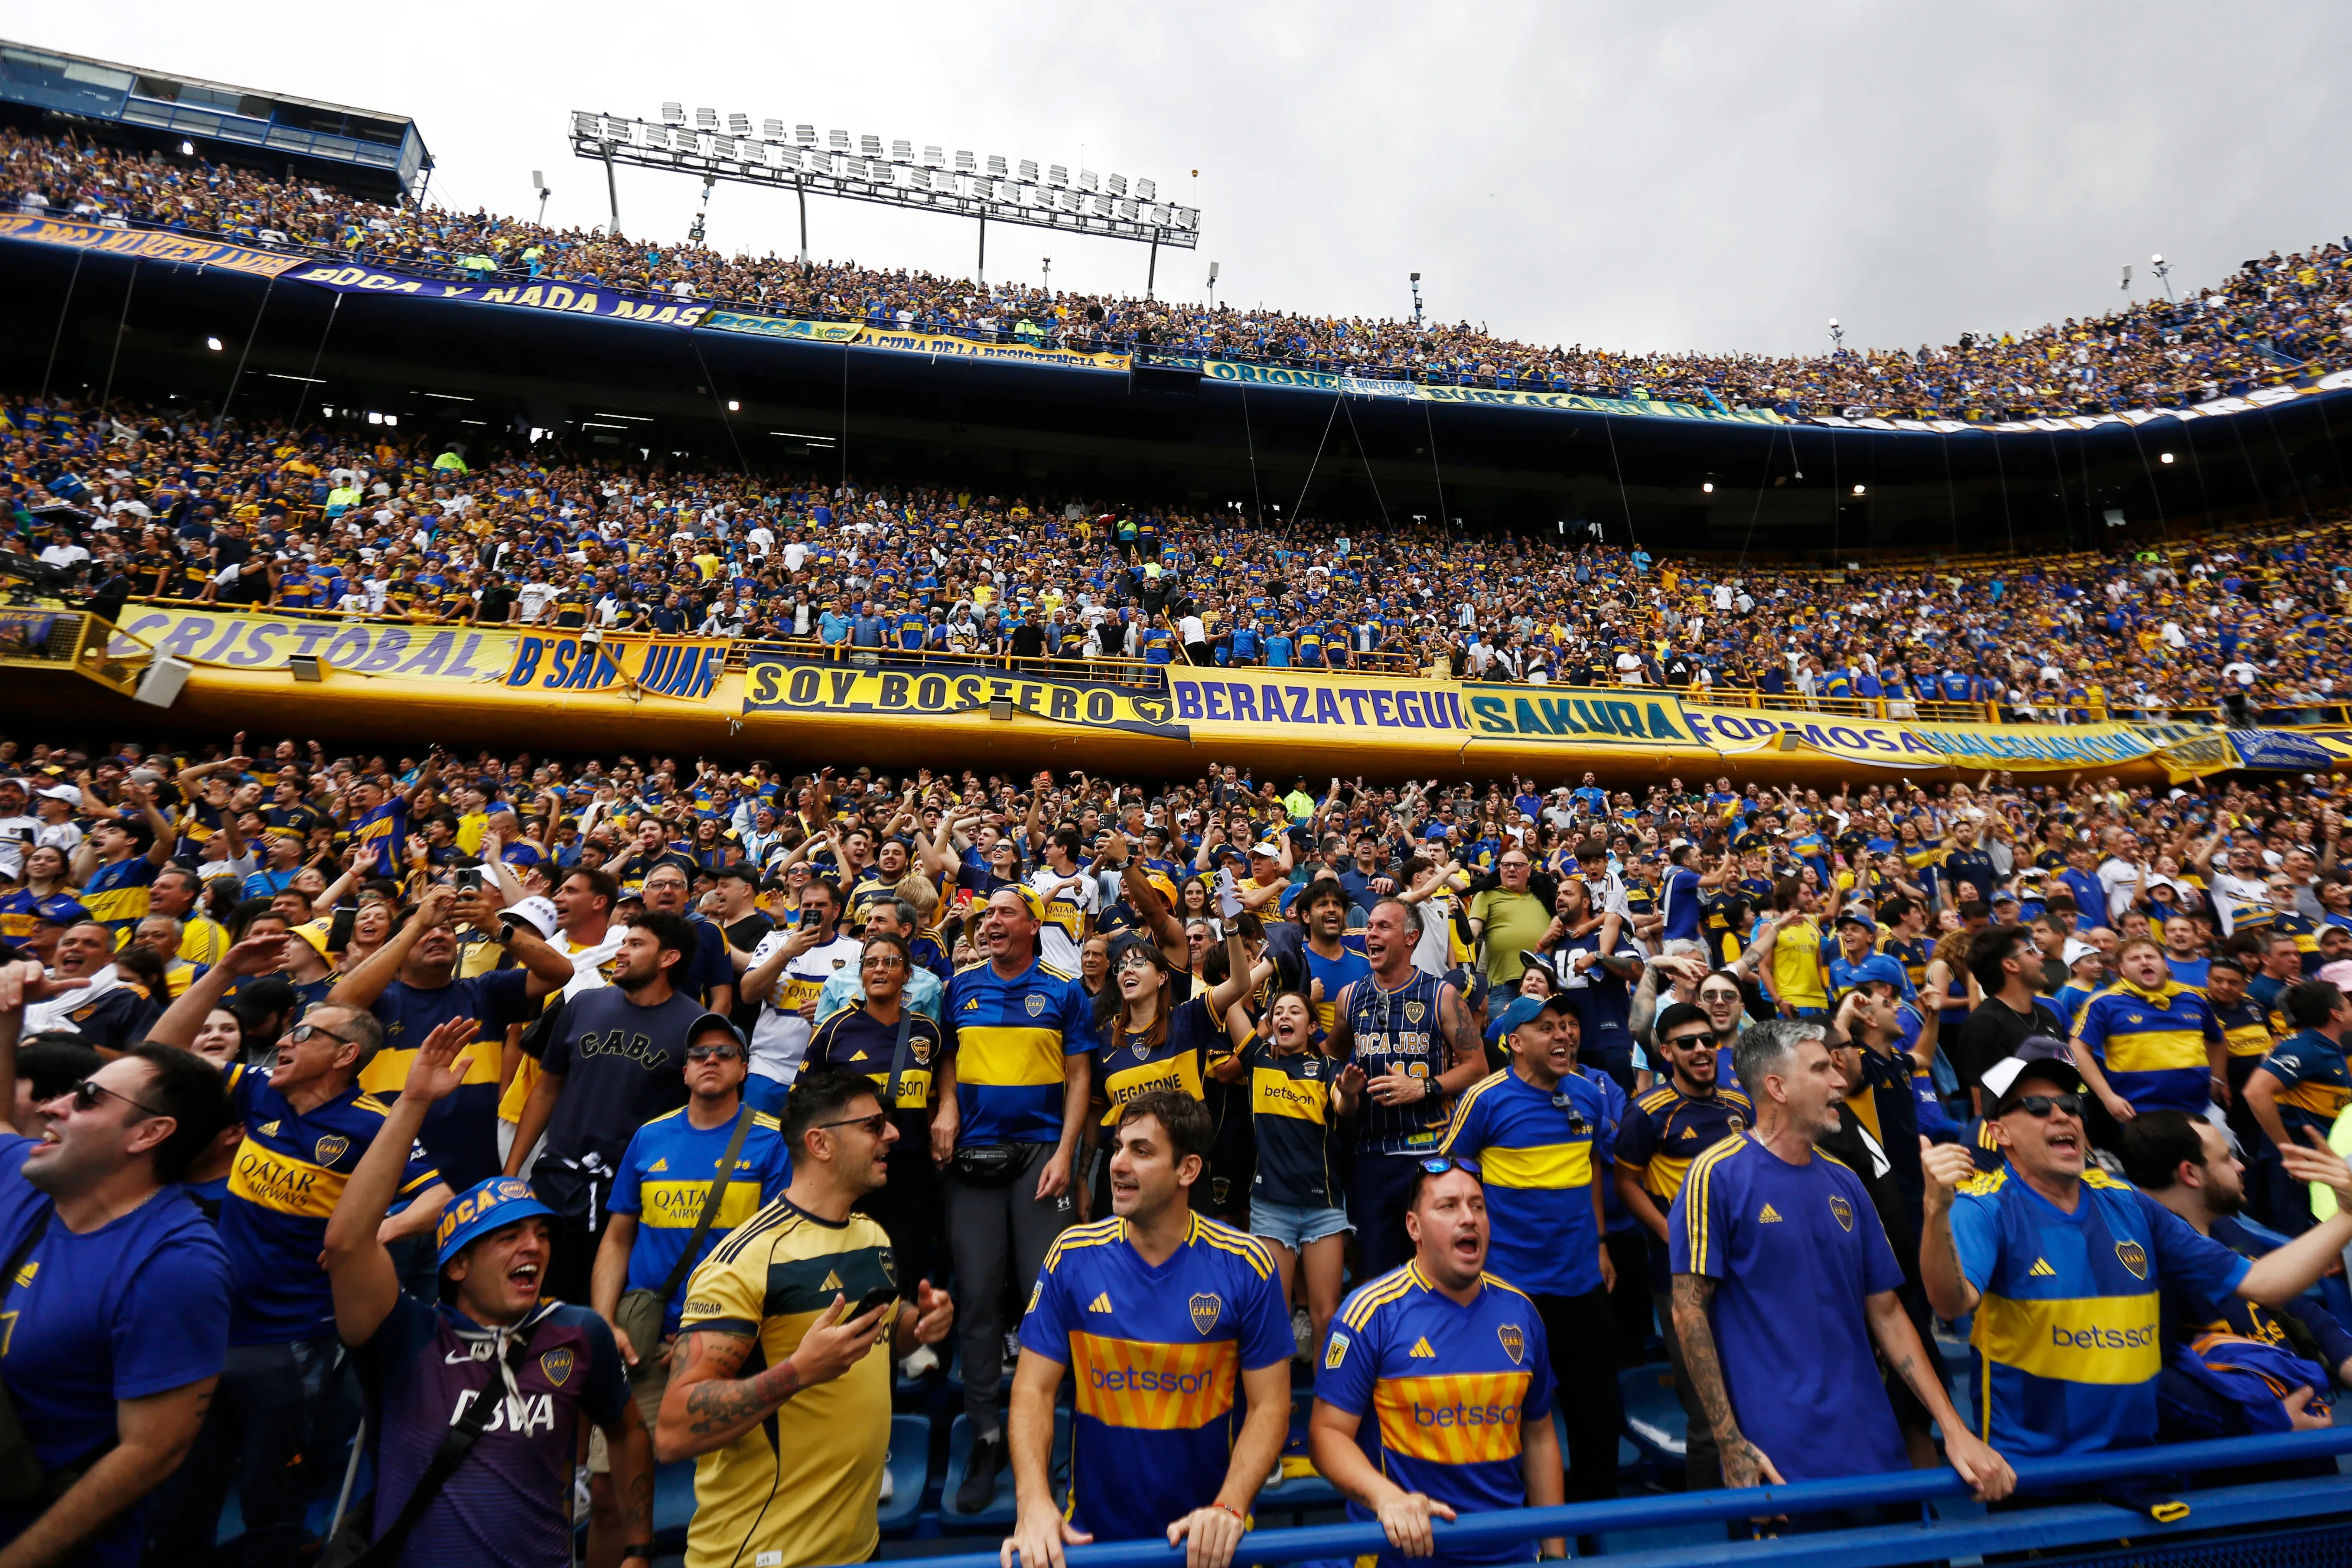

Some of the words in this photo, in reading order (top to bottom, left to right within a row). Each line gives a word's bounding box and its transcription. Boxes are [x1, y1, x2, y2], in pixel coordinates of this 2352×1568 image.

[295, 267, 423, 293] BOCA
[441, 286, 473, 297] Y
[478, 285, 598, 313] NADA
[607, 300, 707, 326] MAS
[708, 313, 812, 336] BOCA
[878, 336, 927, 351] CUNA
[930, 341, 954, 354] DE
[955, 343, 978, 355] LA
[1214, 362, 1336, 389] ORIONE
[1340, 378, 1353, 387] OS
[1356, 380, 1415, 394] BOSTEROS
[107, 613, 483, 677] CRISTOBAL
[543, 639, 625, 689] SAN
[637, 644, 726, 698] JUAN
[753, 666, 859, 705] SOY
[879, 674, 1114, 720] BOSTERO
[1173, 681, 1468, 730] BERAZATEGUI
[1471, 696, 1687, 740] SAKURA
[1045, 905, 1075, 914] QATAR
[1554, 948, 1589, 989] 12
[789, 986, 821, 998] QATA
[579, 1030, 669, 1070] CABJ
[1393, 1032, 1430, 1054] JRS
[880, 1080, 925, 1097] tson
[1264, 1085, 1315, 1106] betsson
[237, 1153, 317, 1193] QATAR
[247, 1181, 308, 1207] AIRWAYS
[654, 1189, 708, 1207] QATA
[669, 1208, 722, 1222] AIRWS
[1193, 1307, 1216, 1316] CABJ
[547, 1358, 570, 1369] CABJ
[1090, 1359, 1213, 1395] betsson
